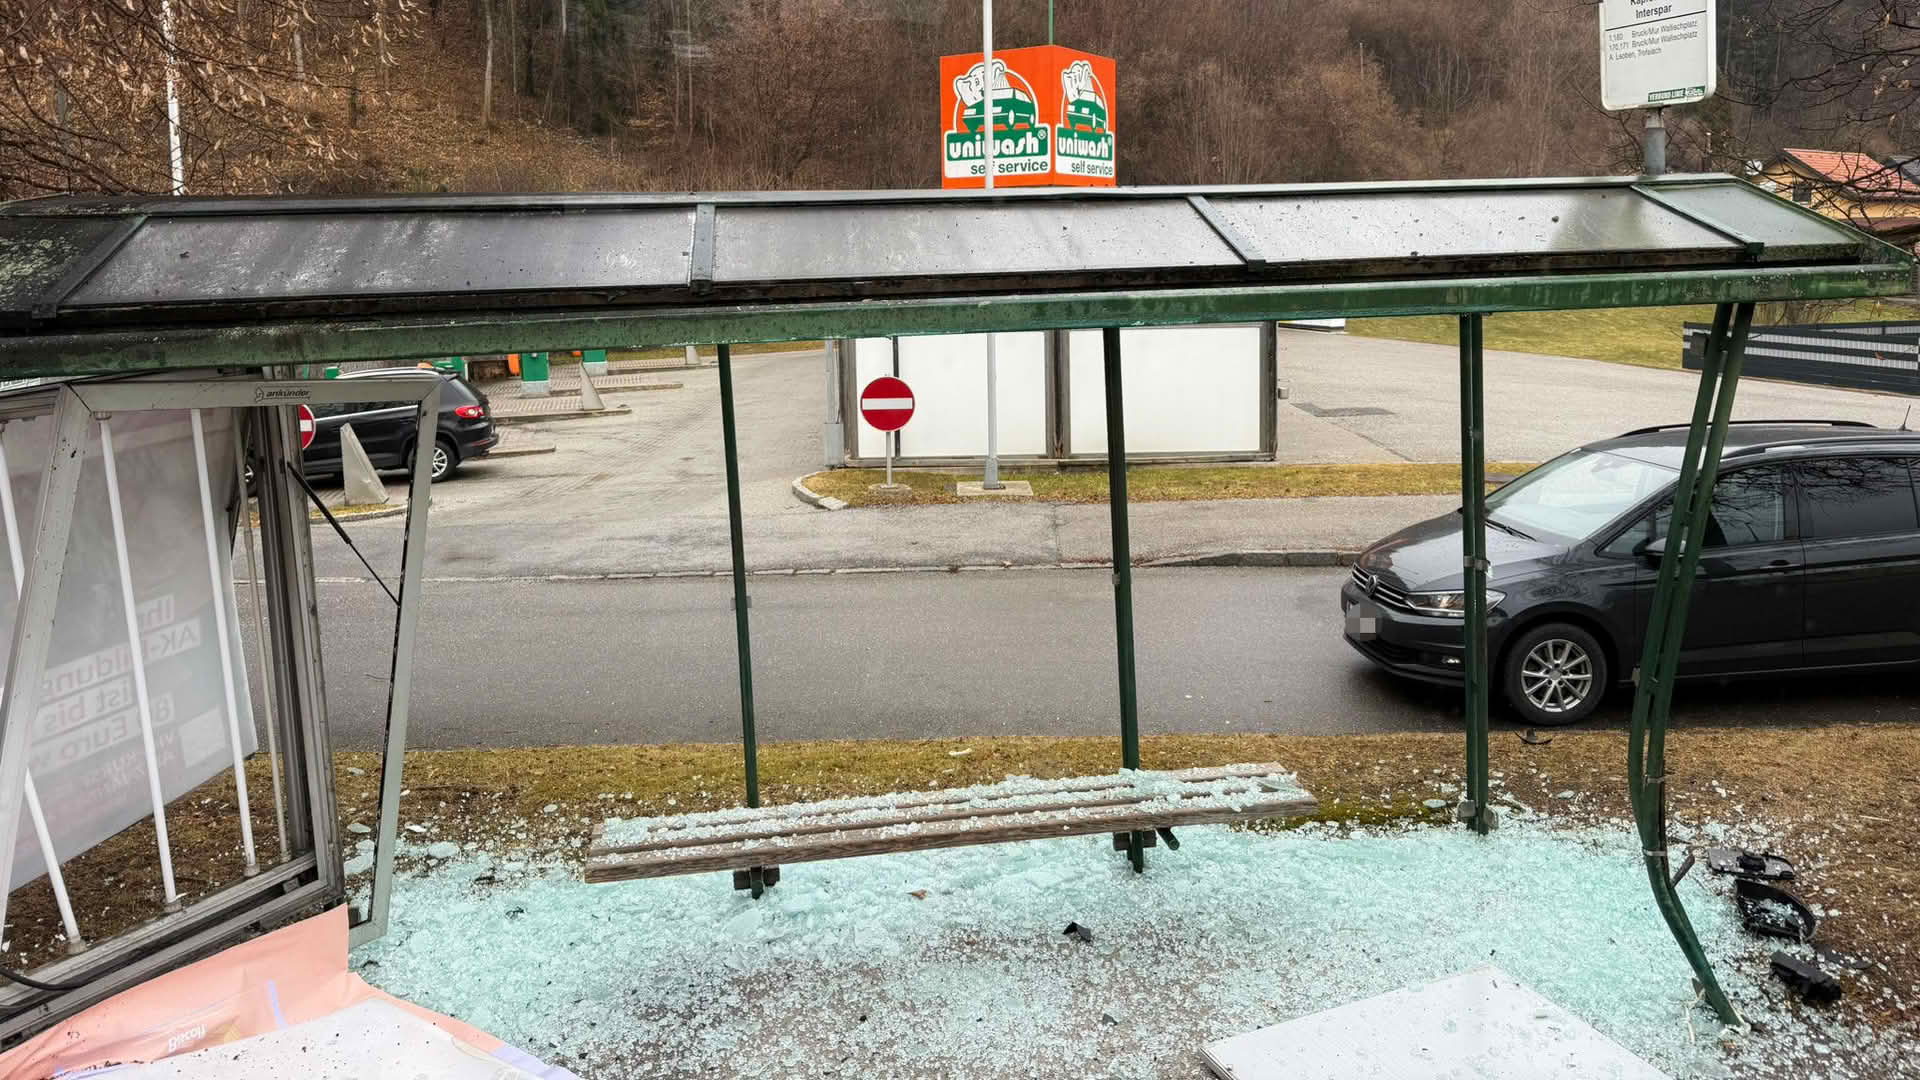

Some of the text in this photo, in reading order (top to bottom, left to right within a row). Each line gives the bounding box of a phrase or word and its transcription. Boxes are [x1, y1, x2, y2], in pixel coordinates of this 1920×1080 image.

[1635, 4, 1673, 19] Interspar
[1058, 131, 1109, 158] uniwash
[998, 159, 1048, 174] service
[1071, 160, 1113, 176] self service
